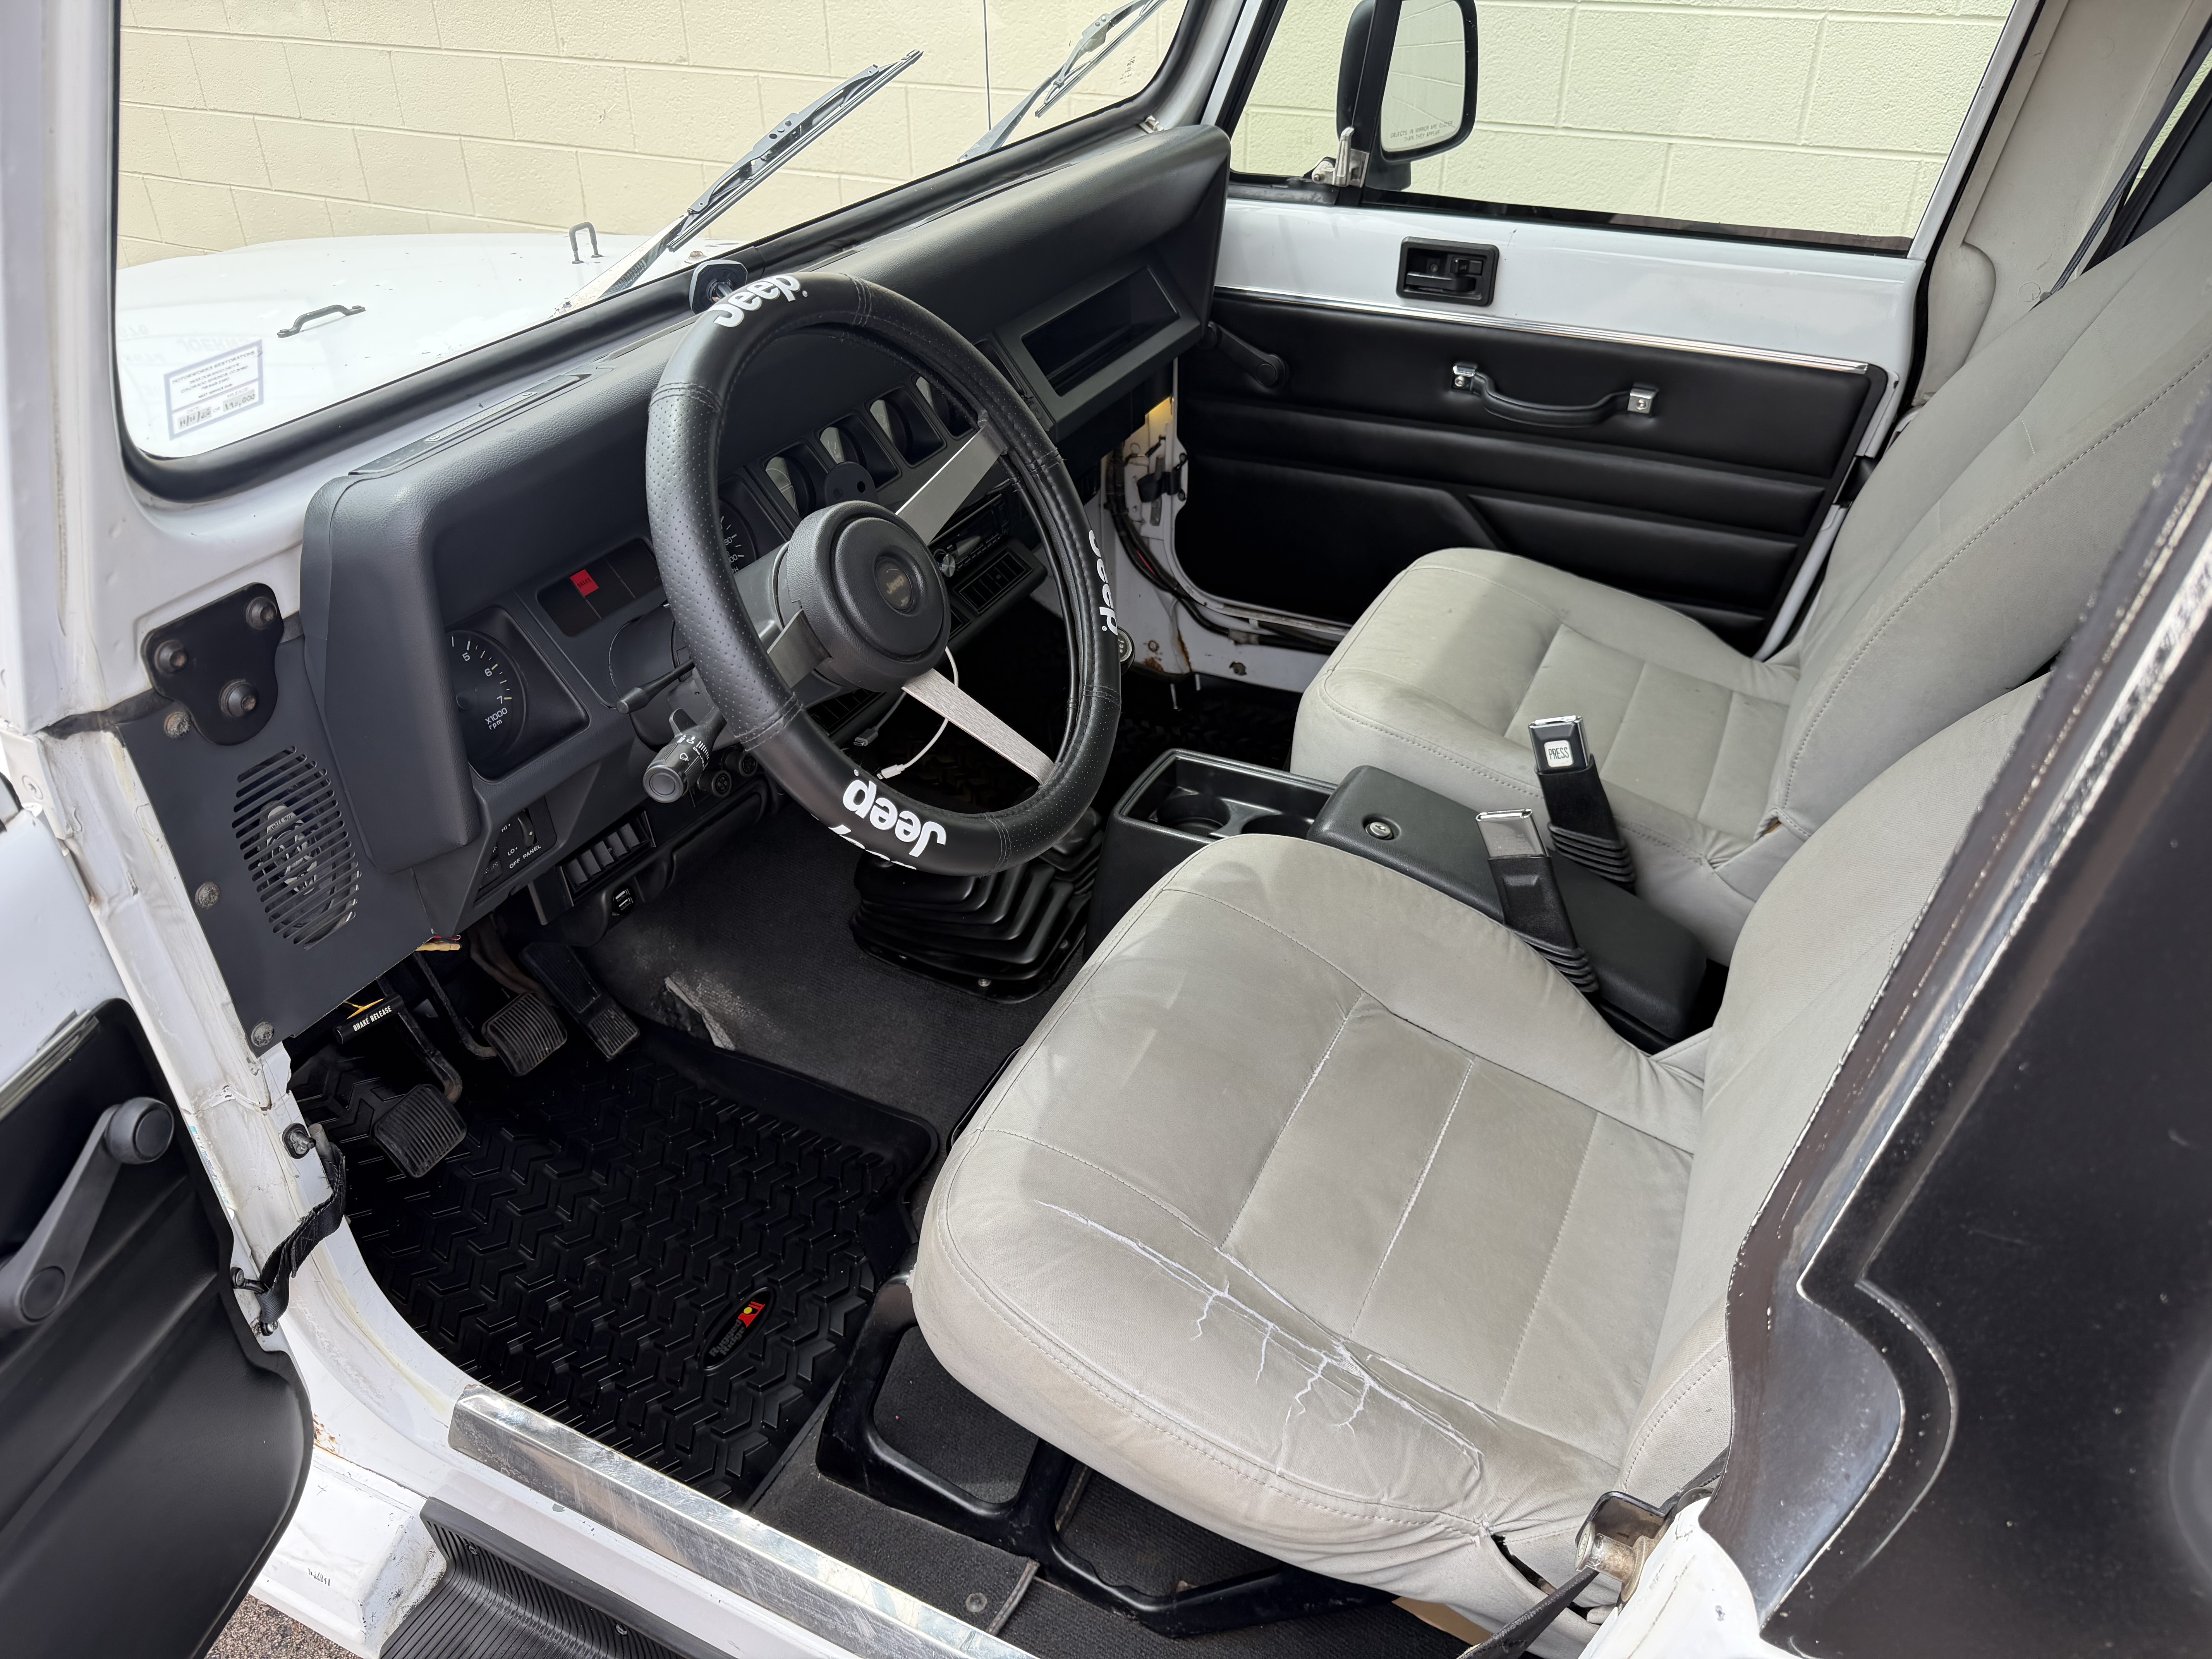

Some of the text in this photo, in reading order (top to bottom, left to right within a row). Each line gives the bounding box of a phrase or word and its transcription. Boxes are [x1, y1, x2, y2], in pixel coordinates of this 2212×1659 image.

[1390, 130, 1407, 138] OBJECTS
[707, 275, 800, 327] Jeep
[576, 577, 592, 588] BRAKE
[886, 575, 904, 594] Jeep
[462, 653, 471, 662] 5
[484, 668, 493, 677] 6
[496, 695, 504, 704] 7
[485, 707, 508, 725] X1000
[488, 718, 503, 730] rpm
[1548, 747, 1570, 760] PRESS
[270, 819, 283, 831] THREE
[843, 780, 947, 857] Jeep
[509, 858, 521, 869] OFF
[522, 844, 541, 859] PANEL
[353, 1005, 392, 1032] BRAKE RELEASE
[709, 1319, 742, 1357] Rugged
[720, 1326, 745, 1356] Ridge
